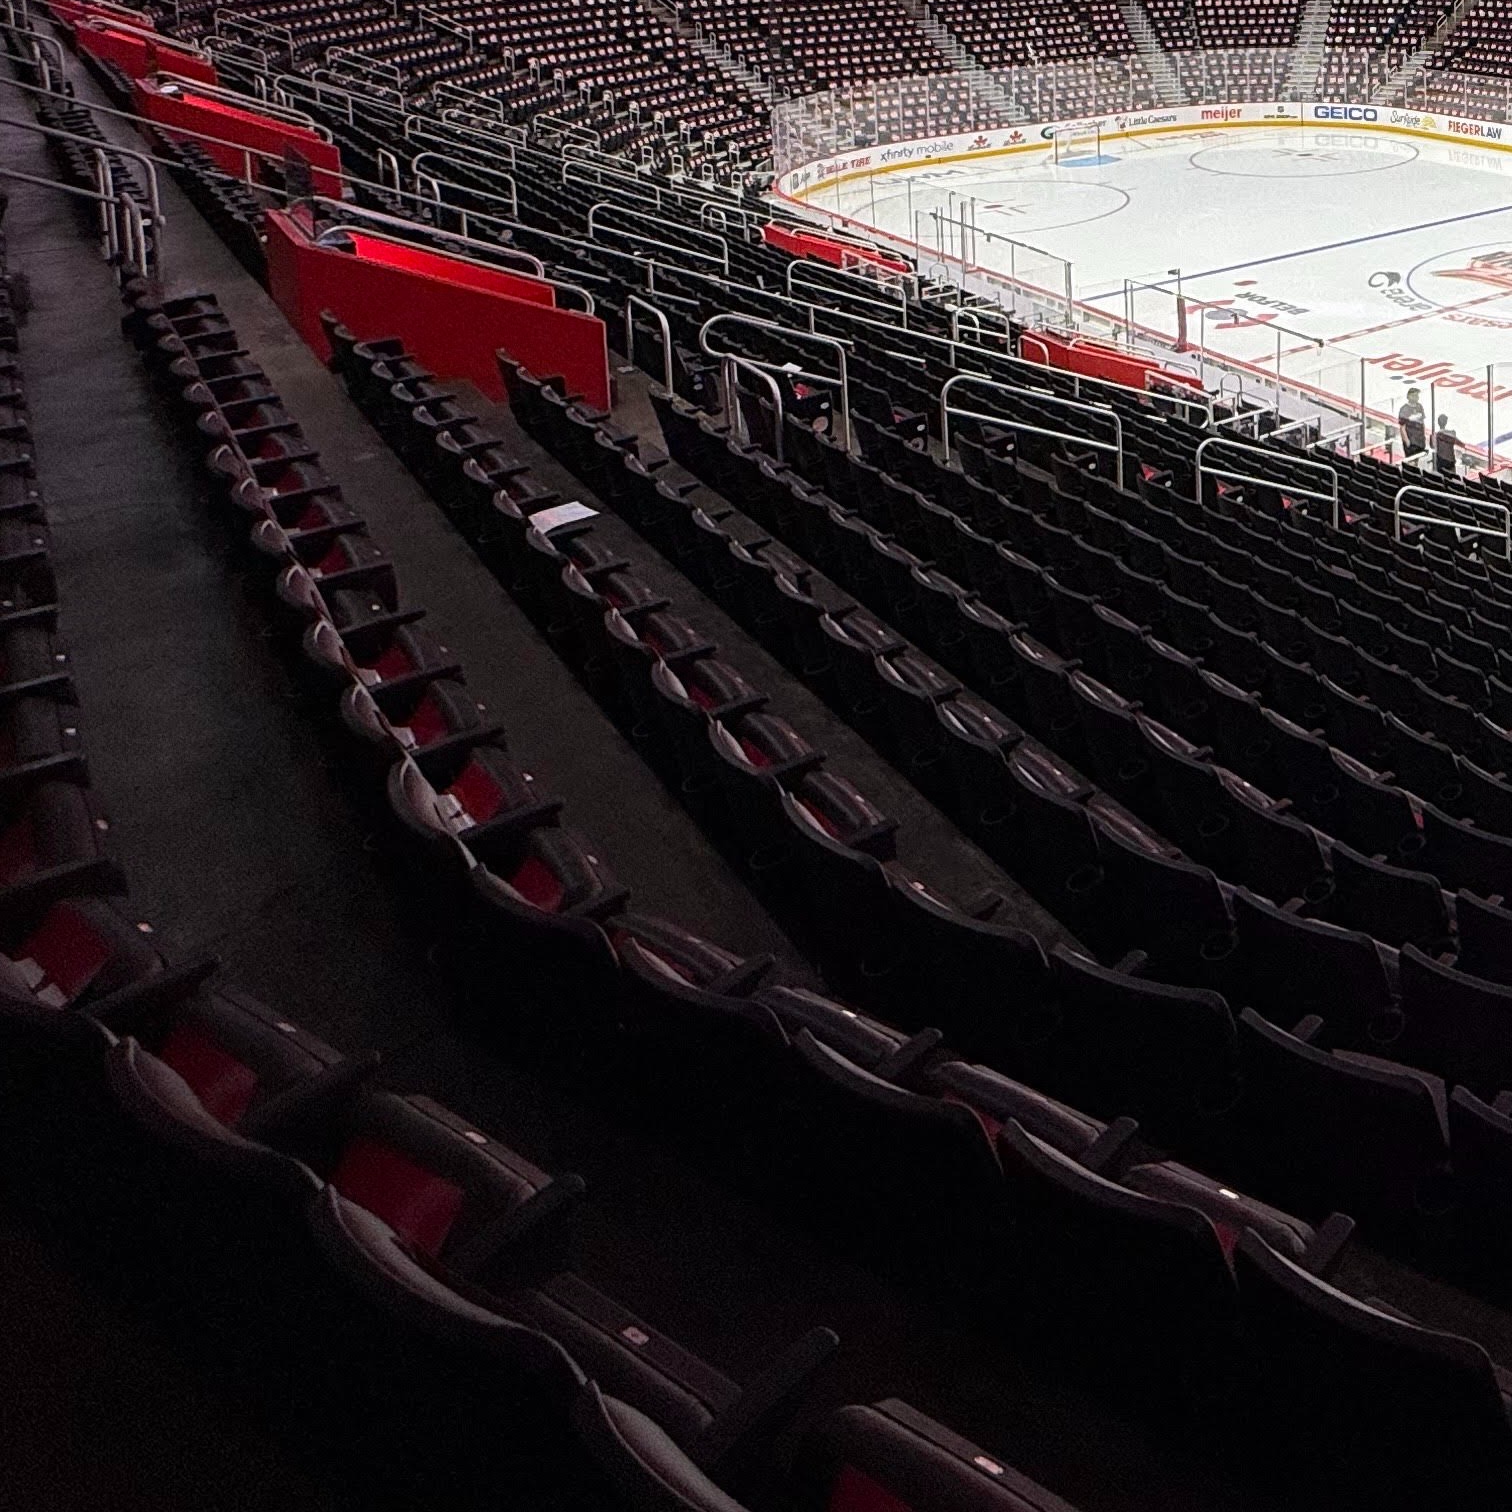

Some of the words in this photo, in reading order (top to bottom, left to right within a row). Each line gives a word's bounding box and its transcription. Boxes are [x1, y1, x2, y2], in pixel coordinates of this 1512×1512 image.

[1201, 106, 1242, 121] meijer
[1314, 105, 1378, 122] GEICO
[880, 148, 914, 162] xfinity
[916, 141, 954, 155] mobile
[1235, 292, 1310, 315] BELFOR
